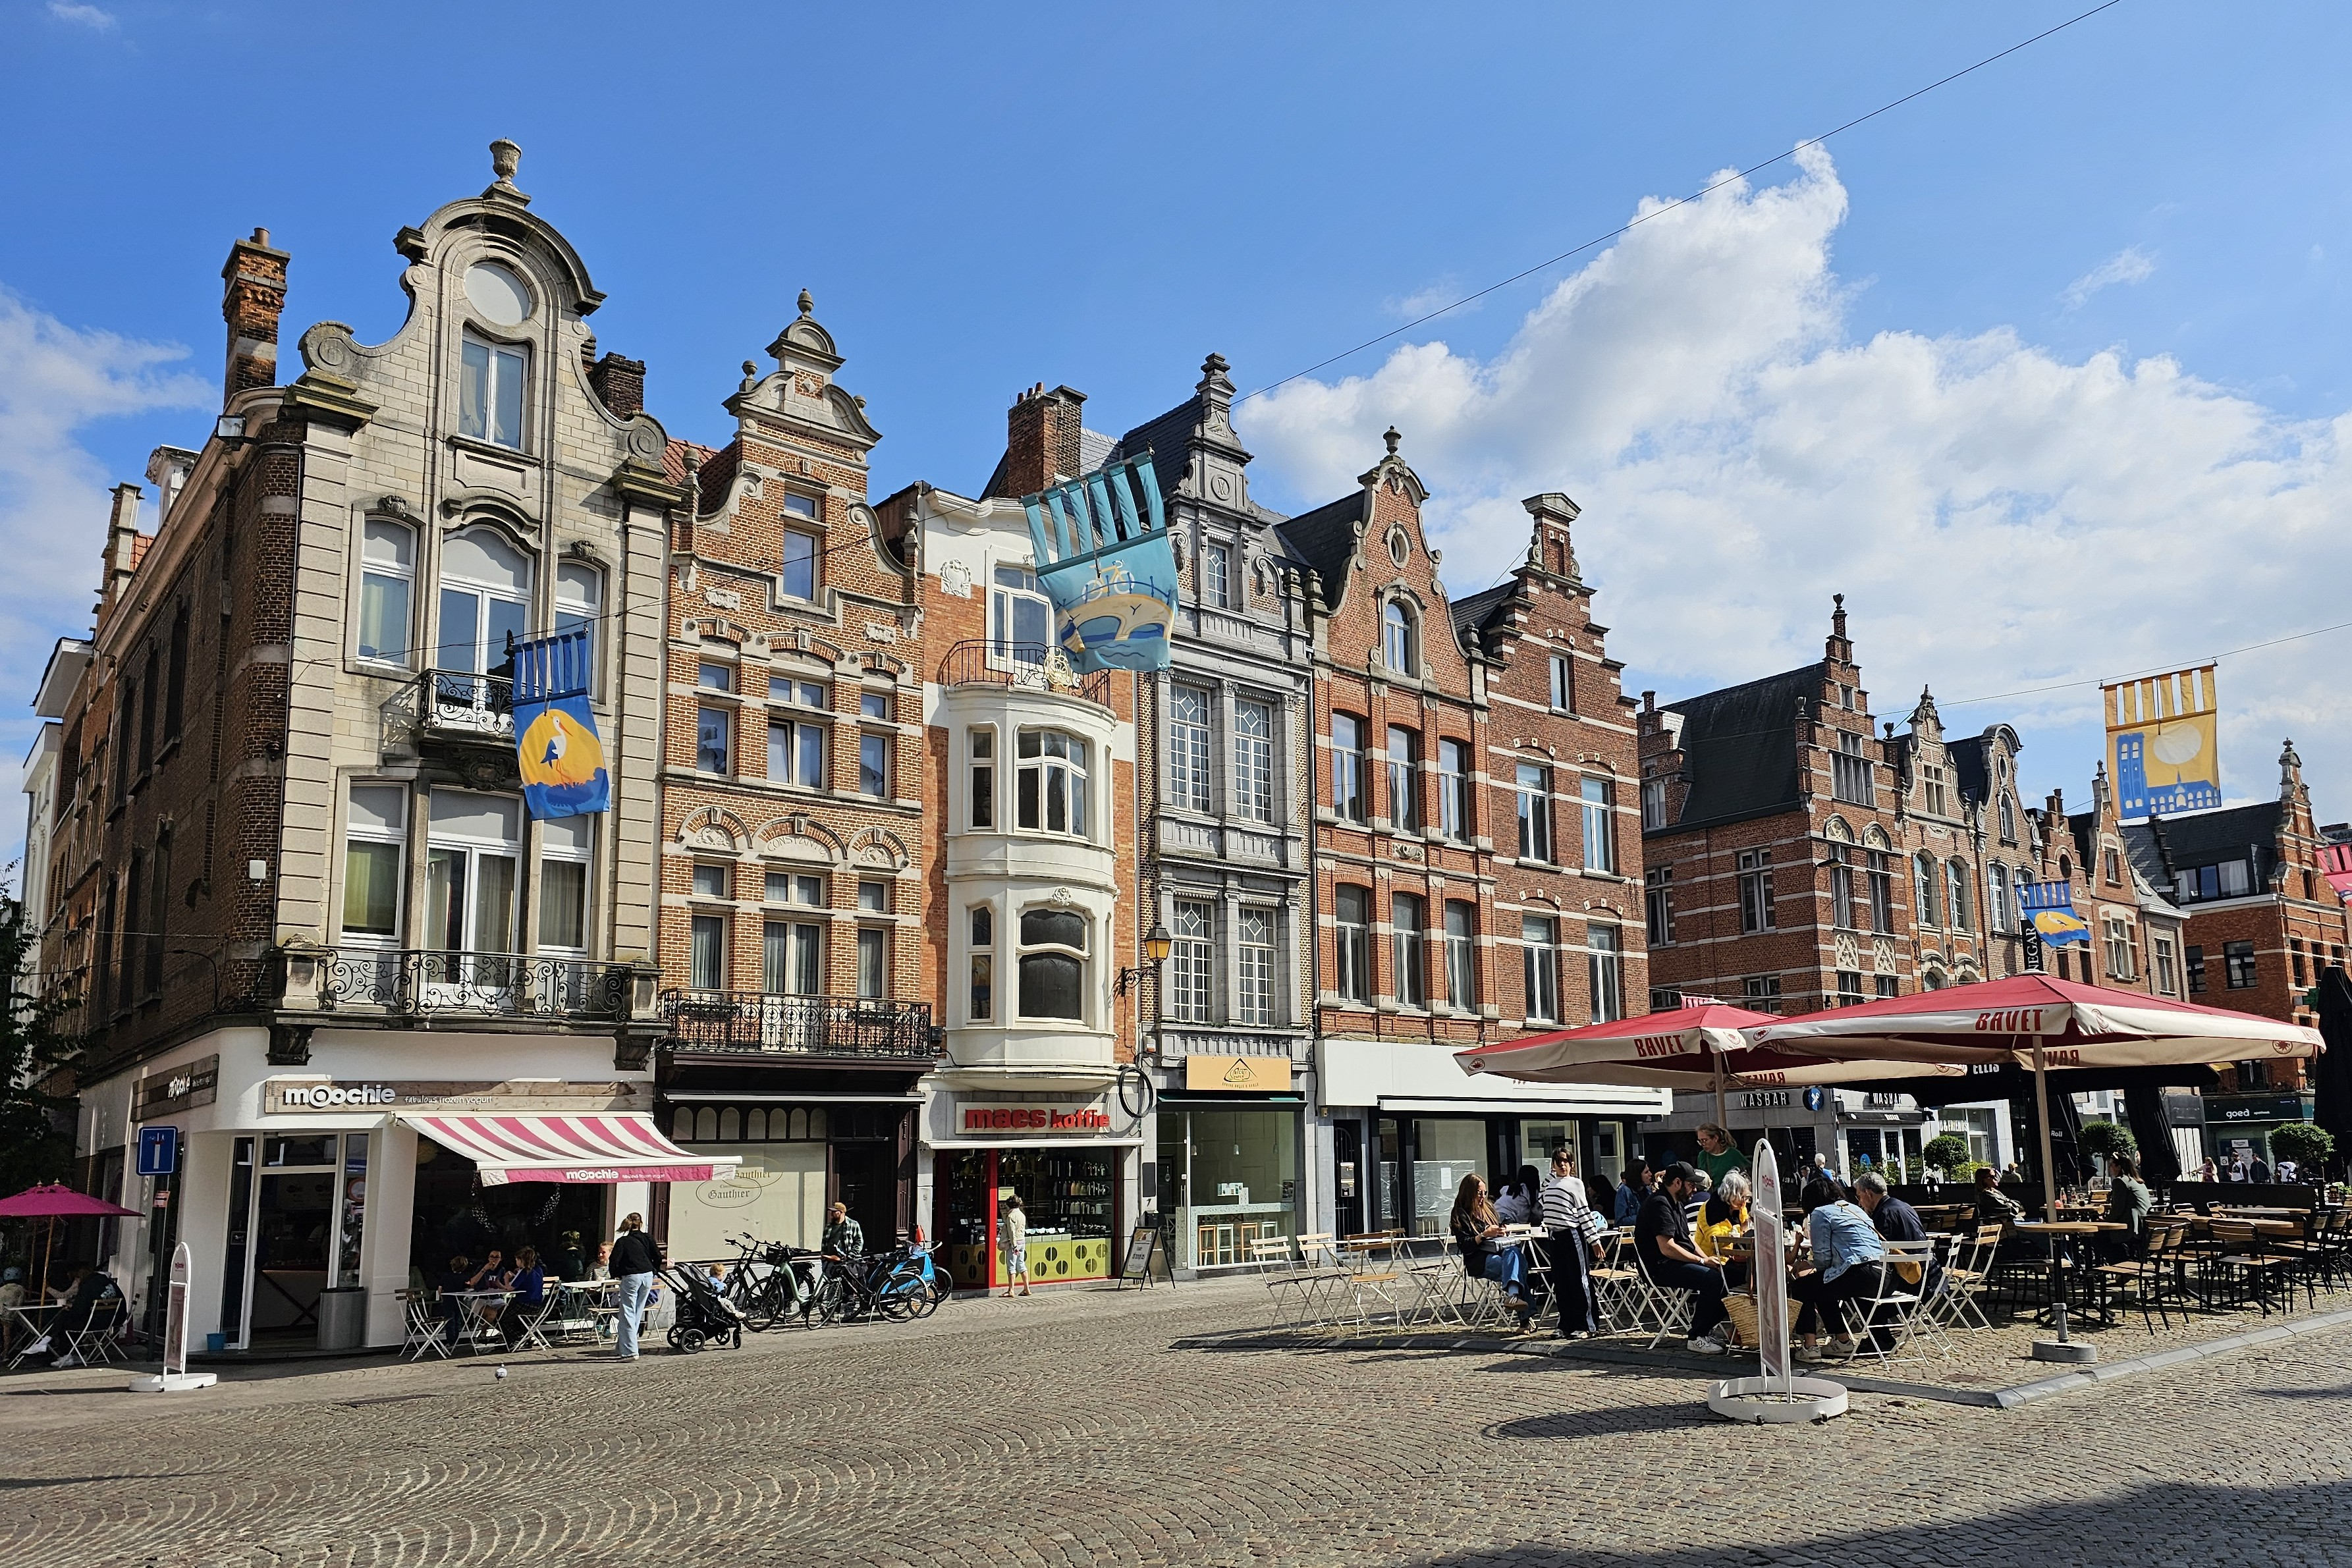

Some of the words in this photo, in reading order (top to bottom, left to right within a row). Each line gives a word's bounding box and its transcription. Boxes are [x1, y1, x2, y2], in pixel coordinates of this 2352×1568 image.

[1975, 1009, 2043, 1031] BAVET
[1633, 1035, 1685, 1058] BAVET
[1973, 1064, 2000, 1074] ELLIS
[285, 1085, 396, 1108] moochie
[404, 1095, 437, 1104] fabulous
[466, 1096, 493, 1105] yogurt
[1739, 1092, 1787, 1108] WASBAR
[965, 1108, 1047, 1129] maes
[1050, 1109, 1110, 1128] koffie
[2226, 1108, 2250, 1119] goed
[566, 1169, 619, 1181] moochie
[708, 1189, 750, 1199] Gauthier
